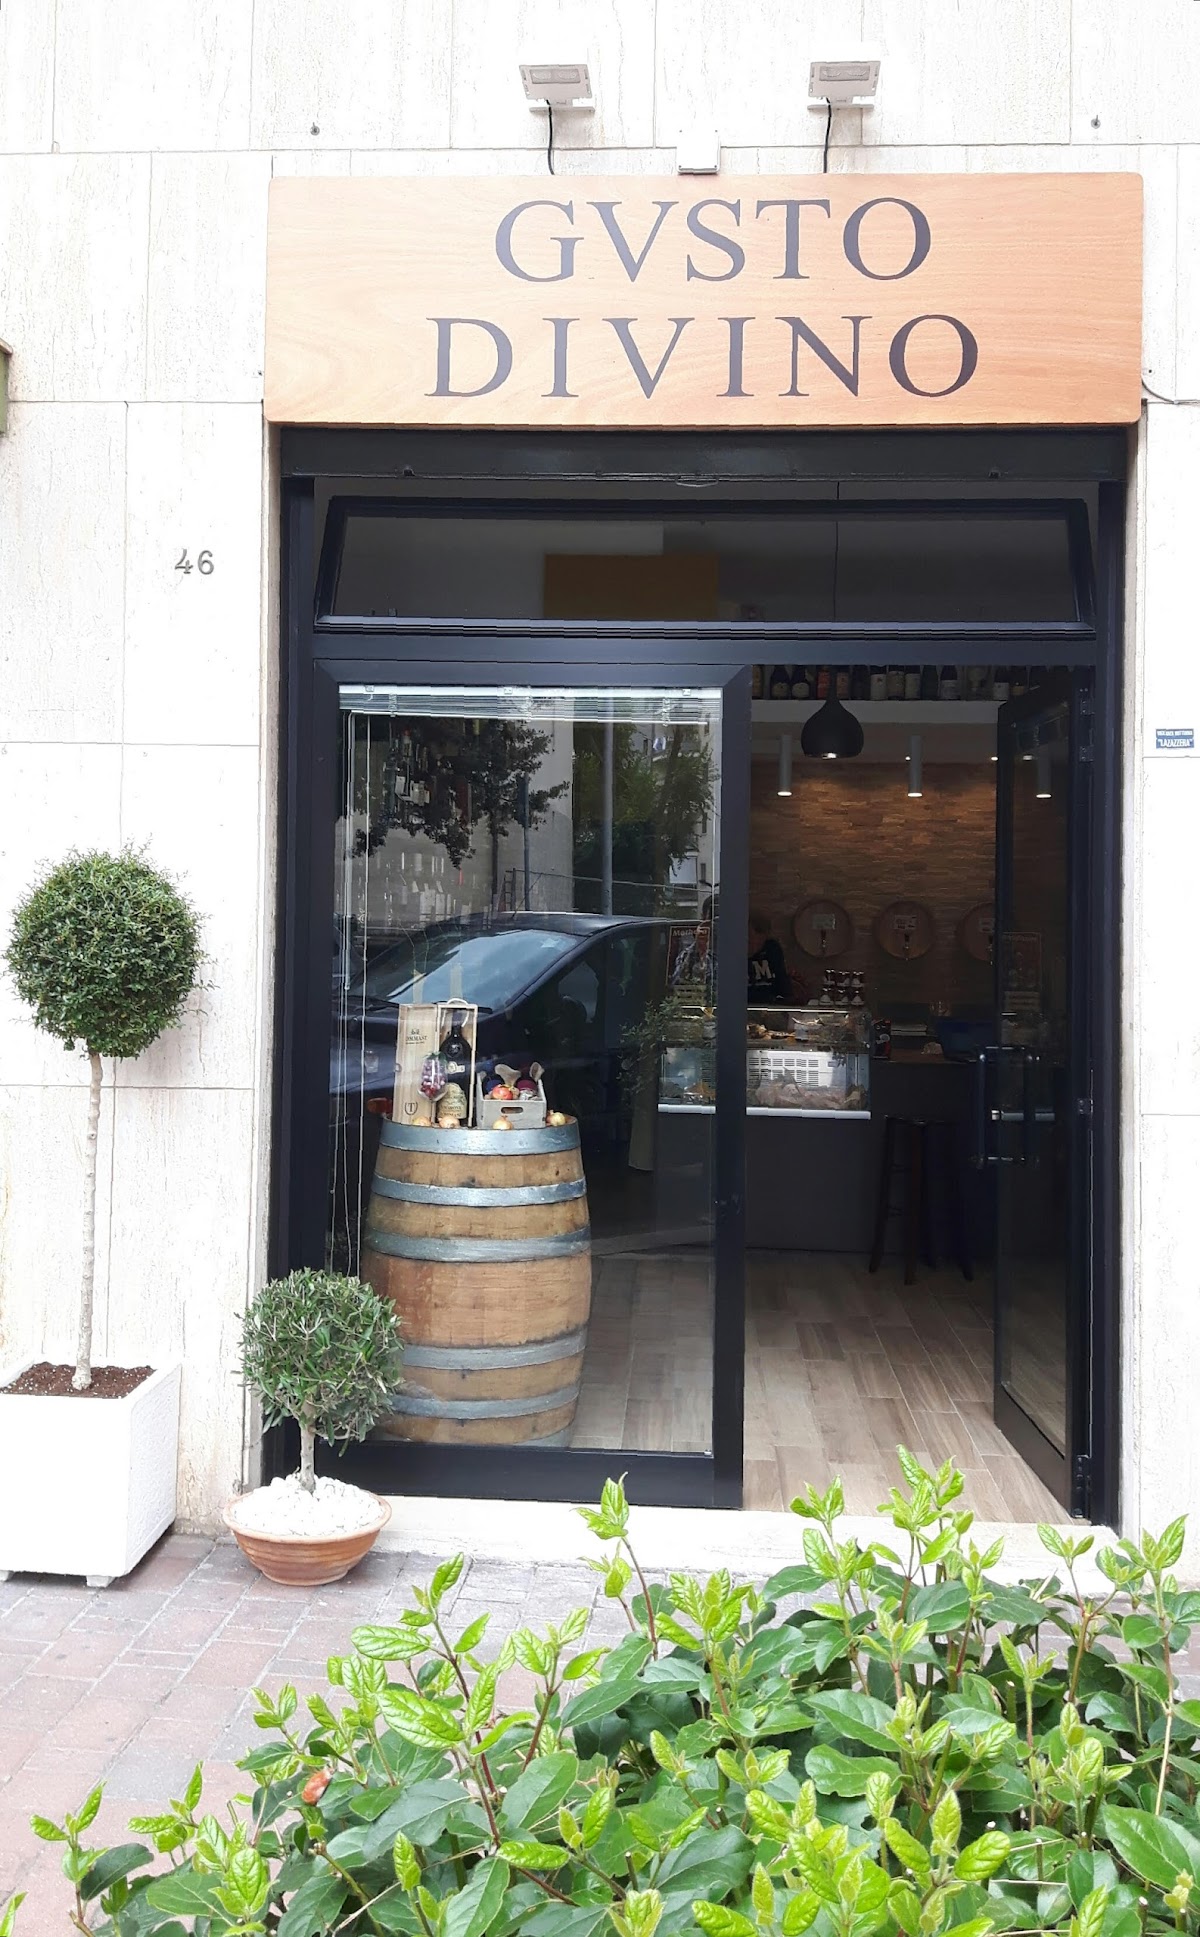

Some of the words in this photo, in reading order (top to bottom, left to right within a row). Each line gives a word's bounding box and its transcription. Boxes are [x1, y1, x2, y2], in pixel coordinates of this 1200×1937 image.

[495, 197, 931, 283] GVSTO
[424, 313, 979, 399] DIVINO
[174, 548, 215, 575] 46
[407, 1102, 416, 1112] T
